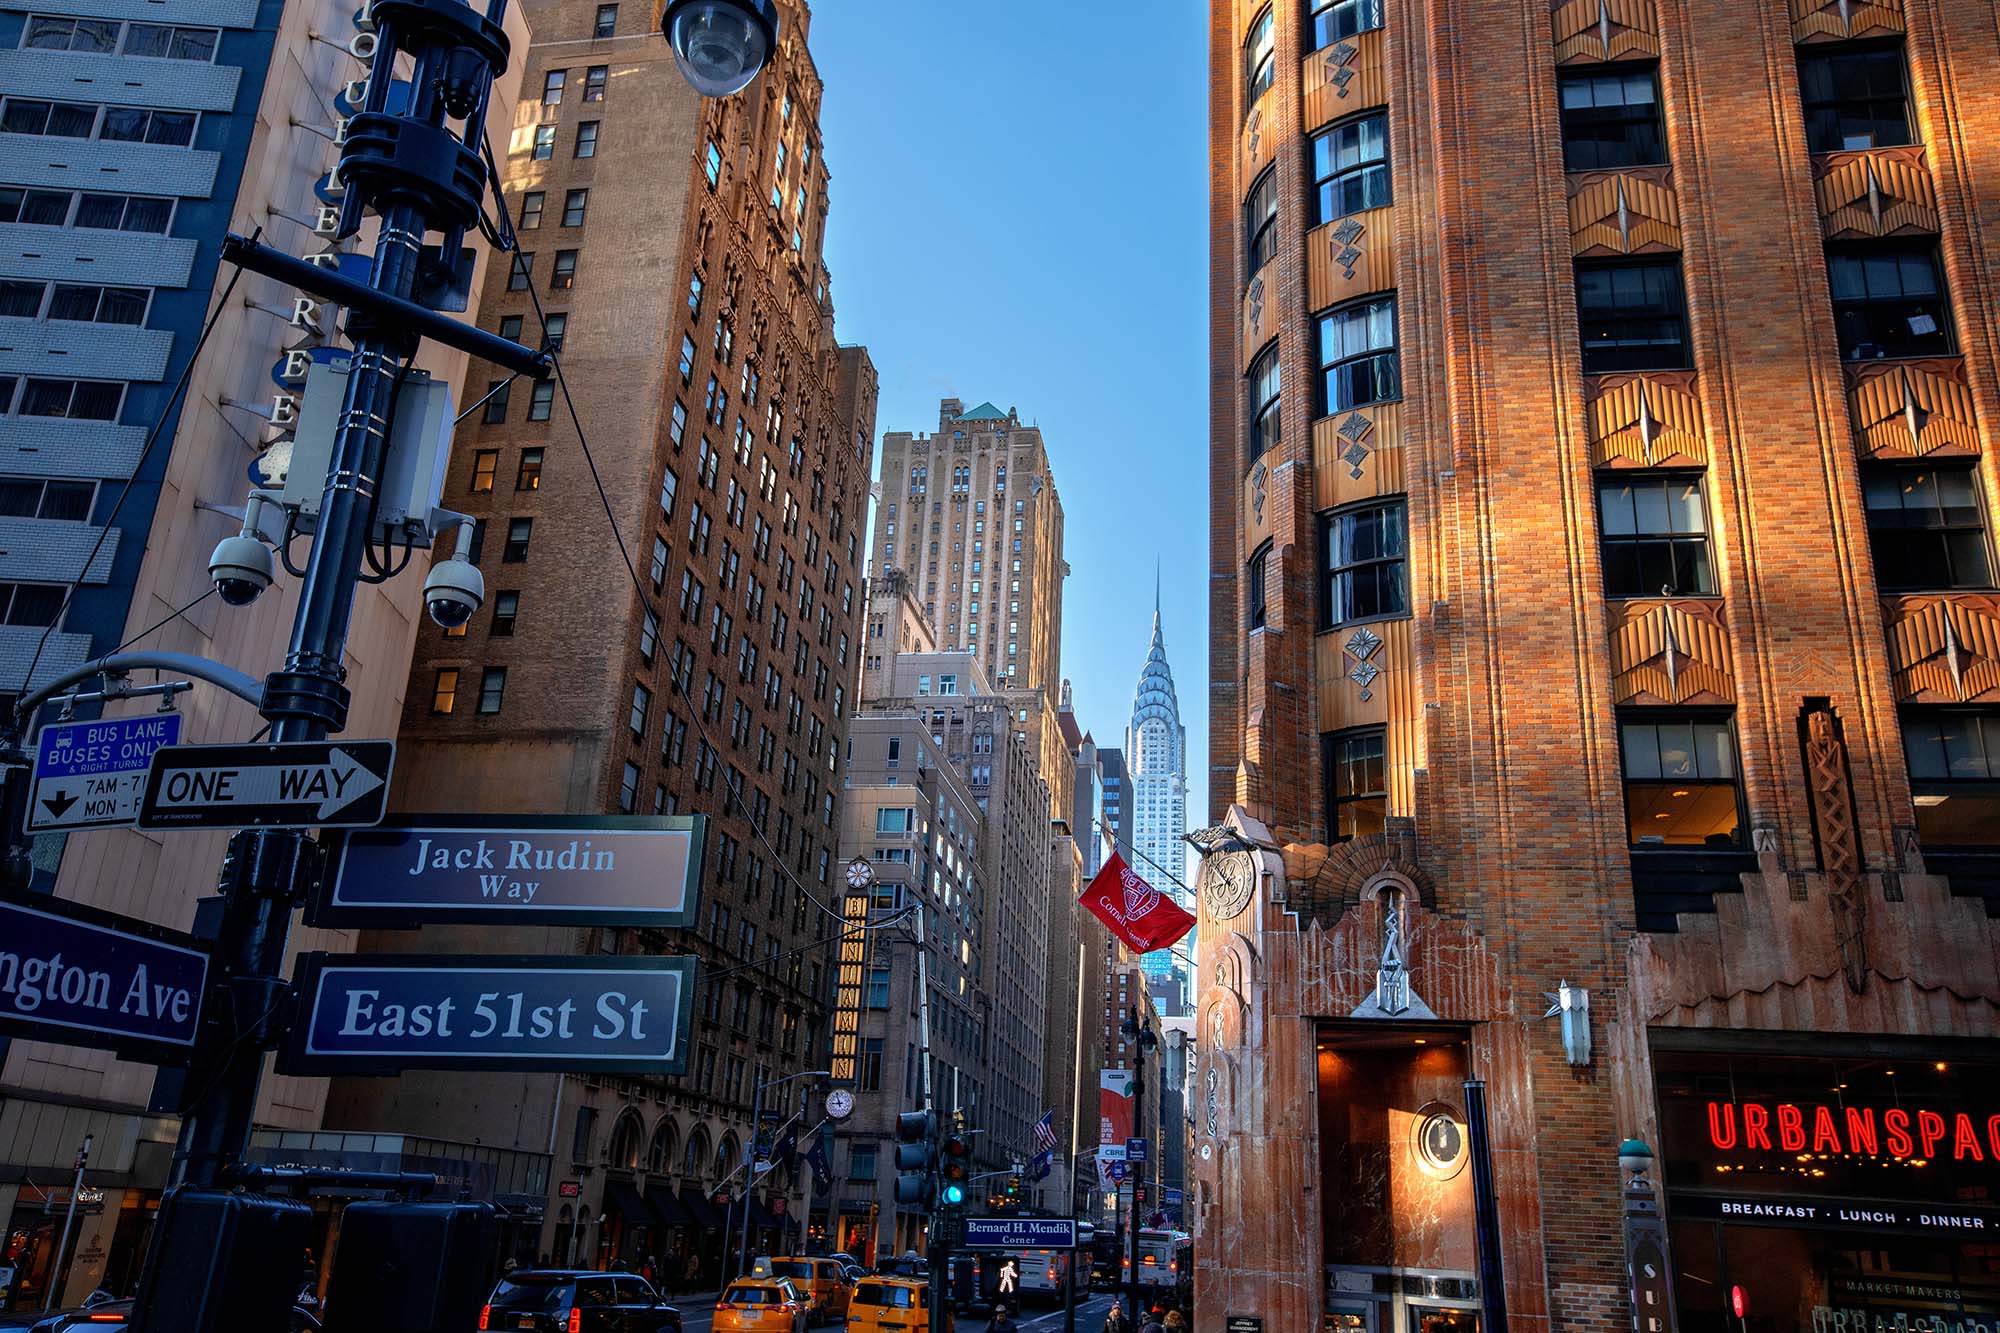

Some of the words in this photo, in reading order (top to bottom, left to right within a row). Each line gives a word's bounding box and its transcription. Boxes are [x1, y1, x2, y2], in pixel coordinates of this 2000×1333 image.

[87, 726, 118, 744] BUS
[124, 721, 166, 738] LANE
[48, 745, 111, 765] BUSES
[121, 739, 168, 759] ONLY
[80, 762, 109, 773] RIGHT
[113, 759, 144, 770] TURNS
[86, 778, 118, 795] 7AM
[166, 771, 238, 802] ONE
[279, 767, 357, 801] WAY
[84, 799, 117, 817] MON
[409, 838, 495, 876] Jack
[505, 839, 617, 871] Rudin
[479, 875, 541, 903] Way
[0, 951, 111, 1012] ngton
[119, 963, 190, 1023] Ave
[836, 899, 861, 1078] BENJAMIN
[338, 990, 456, 1038] East
[470, 990, 577, 1040] 51st
[592, 991, 650, 1041] St
[1707, 1101, 2000, 1162] URBANSPAC
[968, 1222, 1011, 1233] Bernard
[1013, 1223, 1026, 1233] H.
[1029, 1222, 1070, 1234] Mendik
[1721, 1203, 1816, 1218] BREAKFAST
[1840, 1209, 1896, 1224] LUNCH
[1920, 1214, 1984, 1229] DINNER
[1002, 1235, 1036, 1245] Corner
[1643, 1263, 1664, 1332] SUB
[1846, 1280, 1900, 1294] MARKET
[1905, 1286, 1961, 1299] MAKERS
